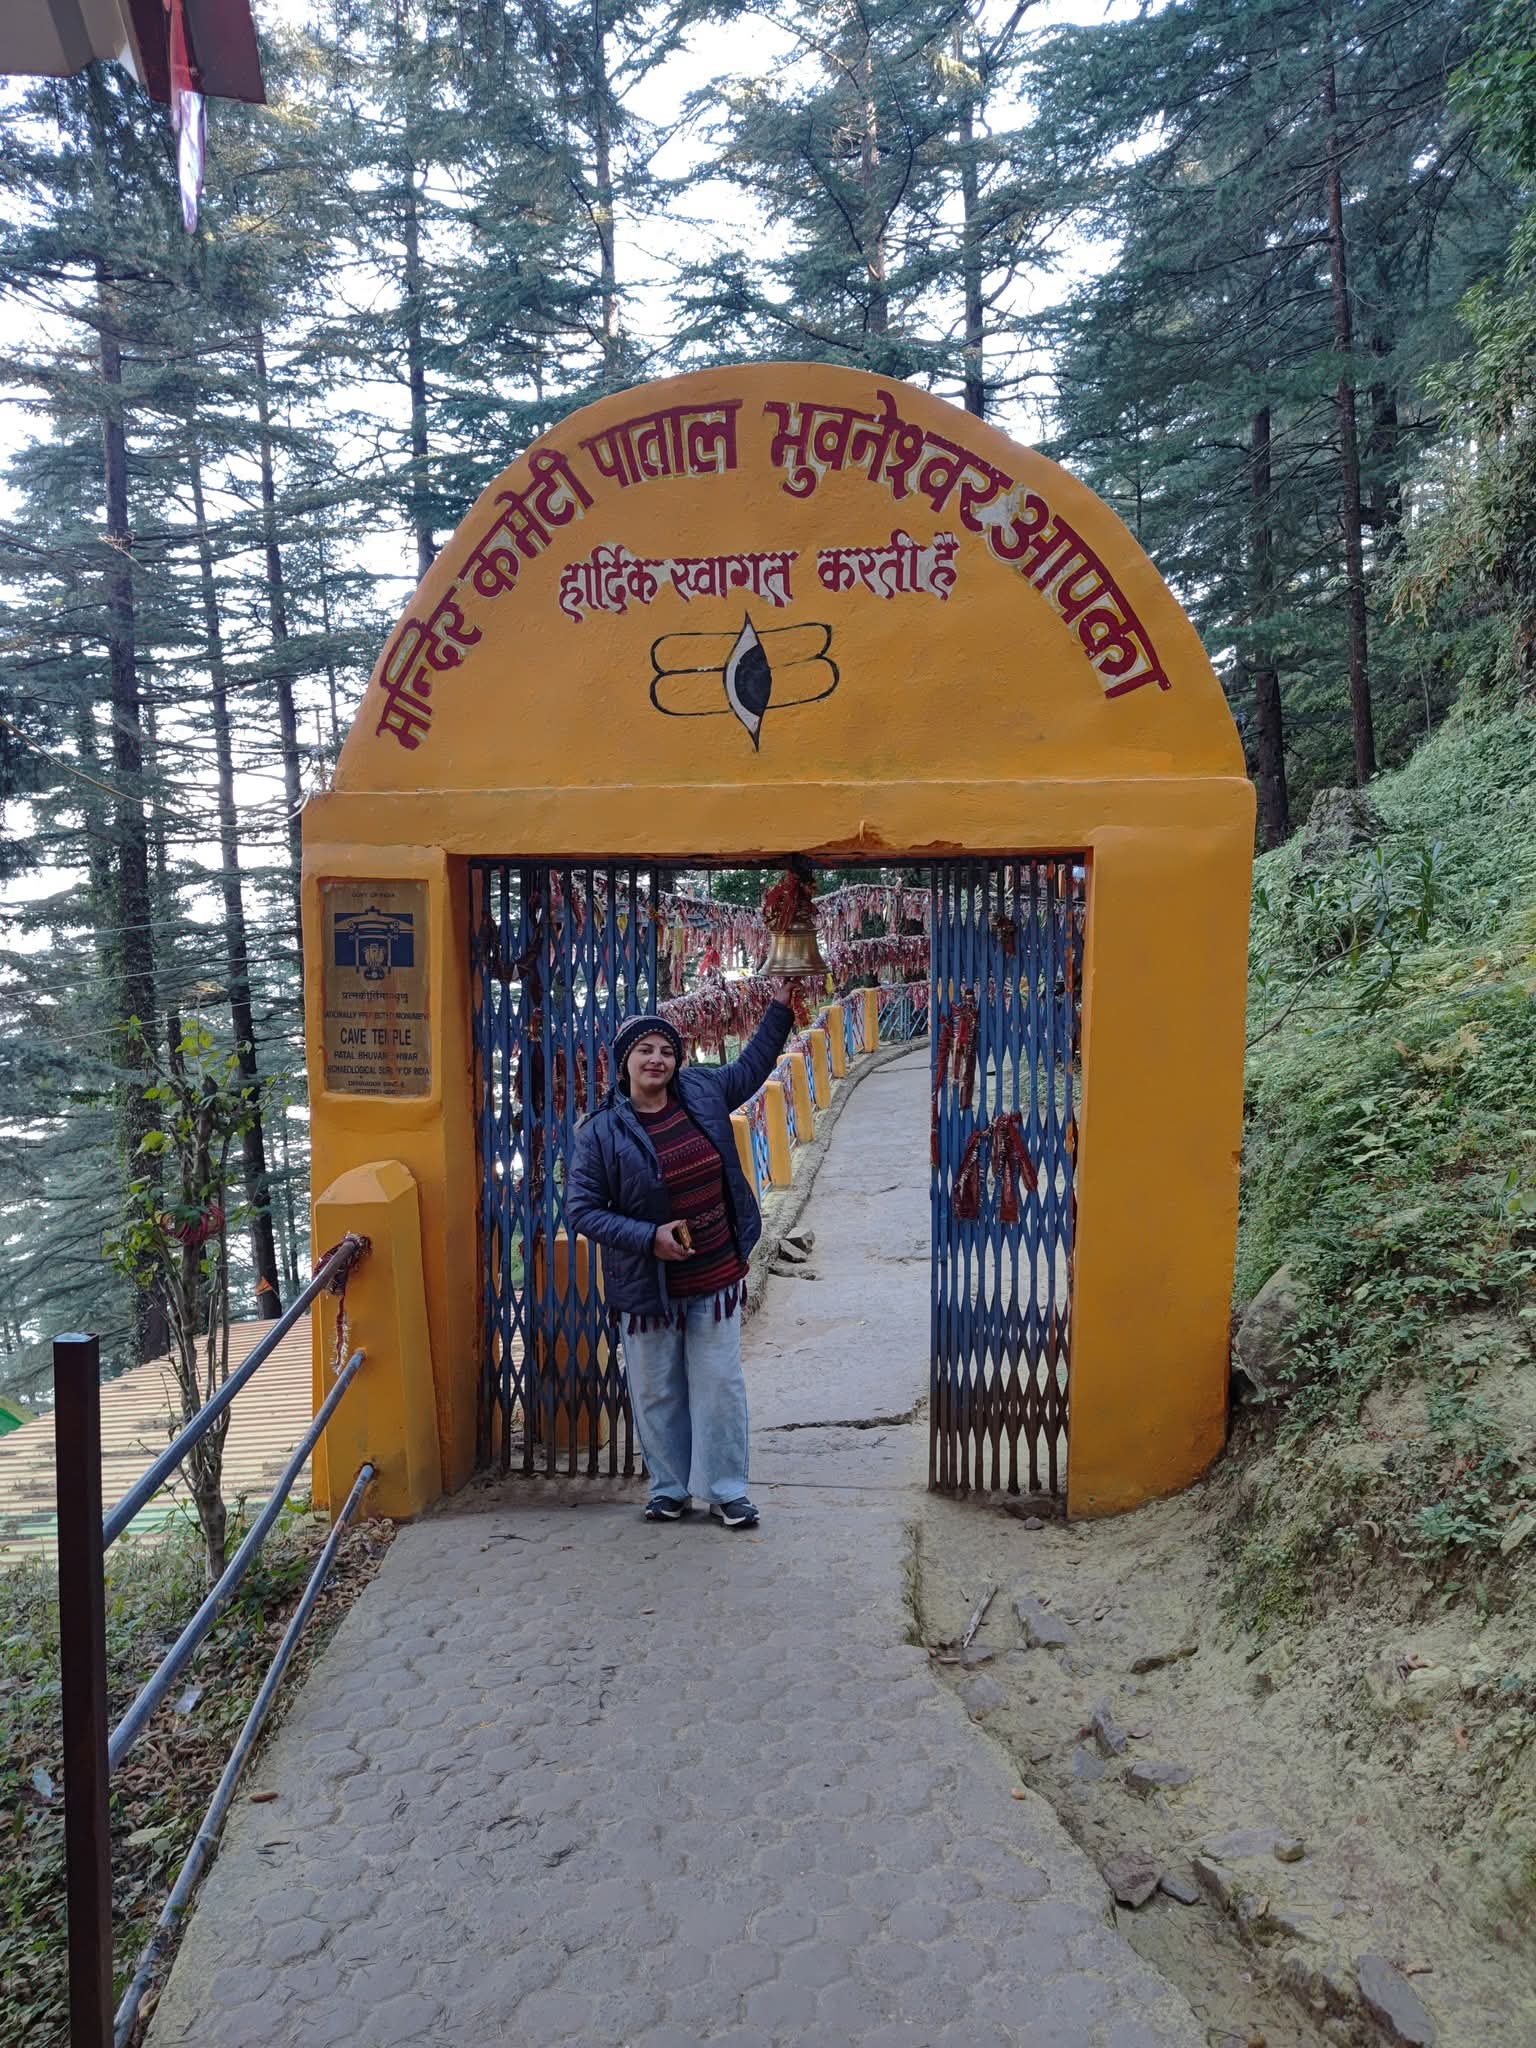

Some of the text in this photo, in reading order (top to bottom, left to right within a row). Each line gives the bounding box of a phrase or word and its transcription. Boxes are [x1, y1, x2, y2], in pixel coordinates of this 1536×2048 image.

[375, 389, 1171, 751] मन्दिर कमेटी पाताल भुवनेश्वर आपका
[558, 528, 961, 624] हार्दिक स्वागत करती है
[340, 1027, 367, 1045] CAVE
[334, 1050, 418, 1061] PATAL BHUVAHWAR
[327, 1065, 377, 1074] RCHAEOLOGICAL
[378, 1066, 402, 1074] SURY
